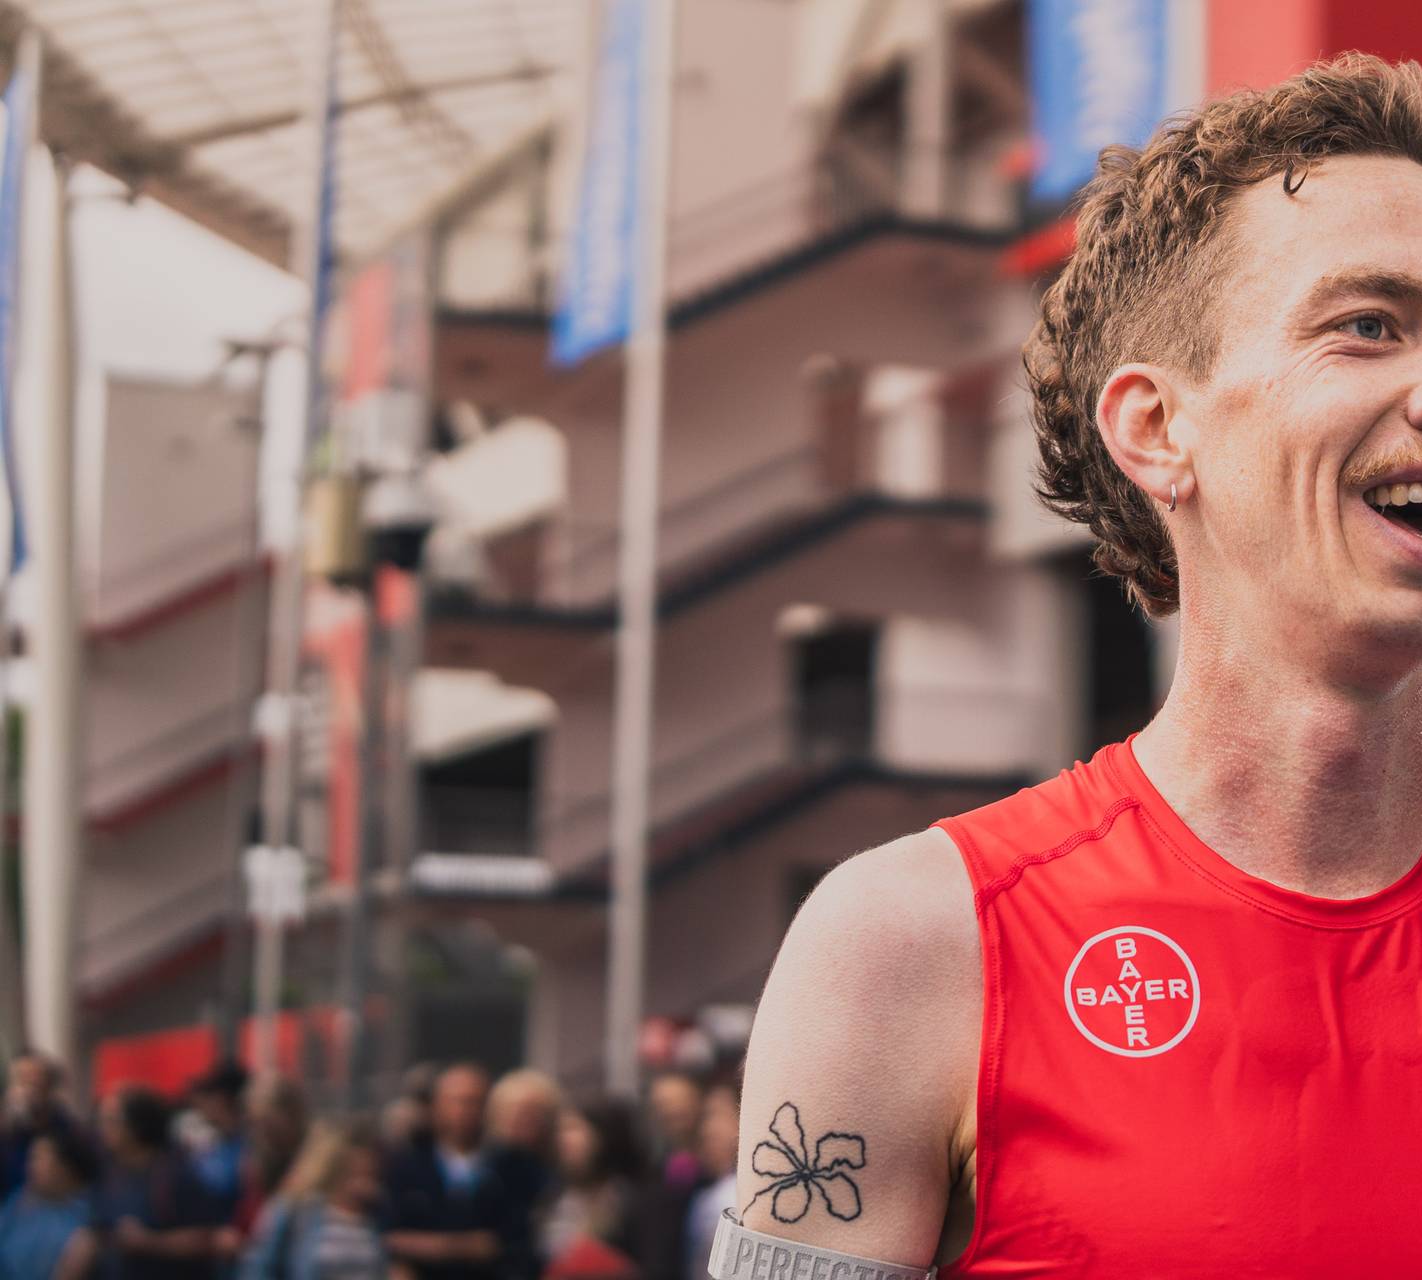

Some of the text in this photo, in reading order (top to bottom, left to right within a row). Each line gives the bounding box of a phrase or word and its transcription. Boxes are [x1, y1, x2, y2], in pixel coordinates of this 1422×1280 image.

[1076, 979, 1189, 1006] BAYER
[1115, 938, 1150, 1047] BAYER
[732, 1237, 924, 1280] PERFECT
